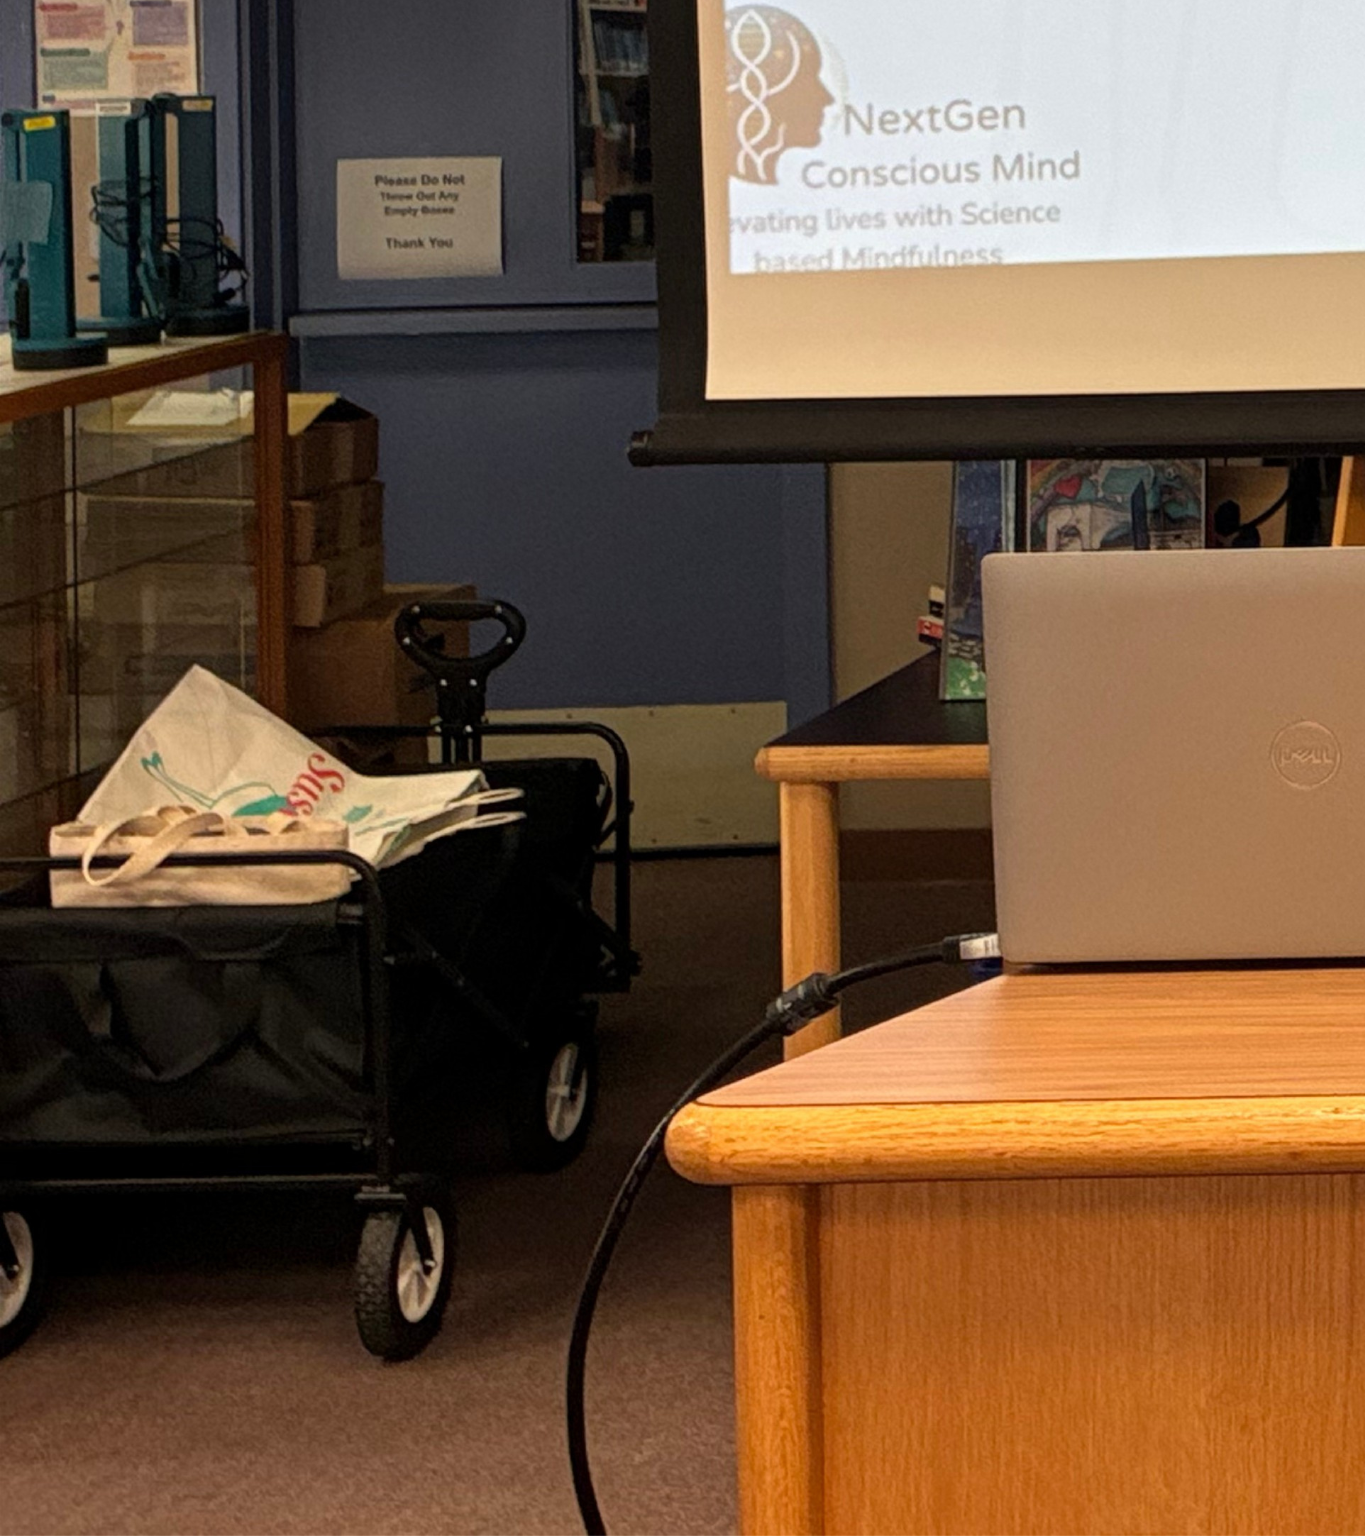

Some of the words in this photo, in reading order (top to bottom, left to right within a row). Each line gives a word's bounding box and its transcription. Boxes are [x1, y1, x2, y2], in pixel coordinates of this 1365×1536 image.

[844, 99, 1026, 136] NextGen
[374, 174, 417, 186] Please
[421, 174, 439, 186] Do
[442, 174, 465, 186] Not
[802, 158, 981, 189] Conscious
[993, 150, 1080, 181] Mind
[826, 206, 887, 231] lives
[895, 205, 953, 228] with
[961, 201, 1061, 225] Science
[386, 237, 424, 249] Thank
[428, 236, 453, 248] You
[842, 245, 1003, 267] Mindfulness
[1280, 747, 1334, 767] DELL
